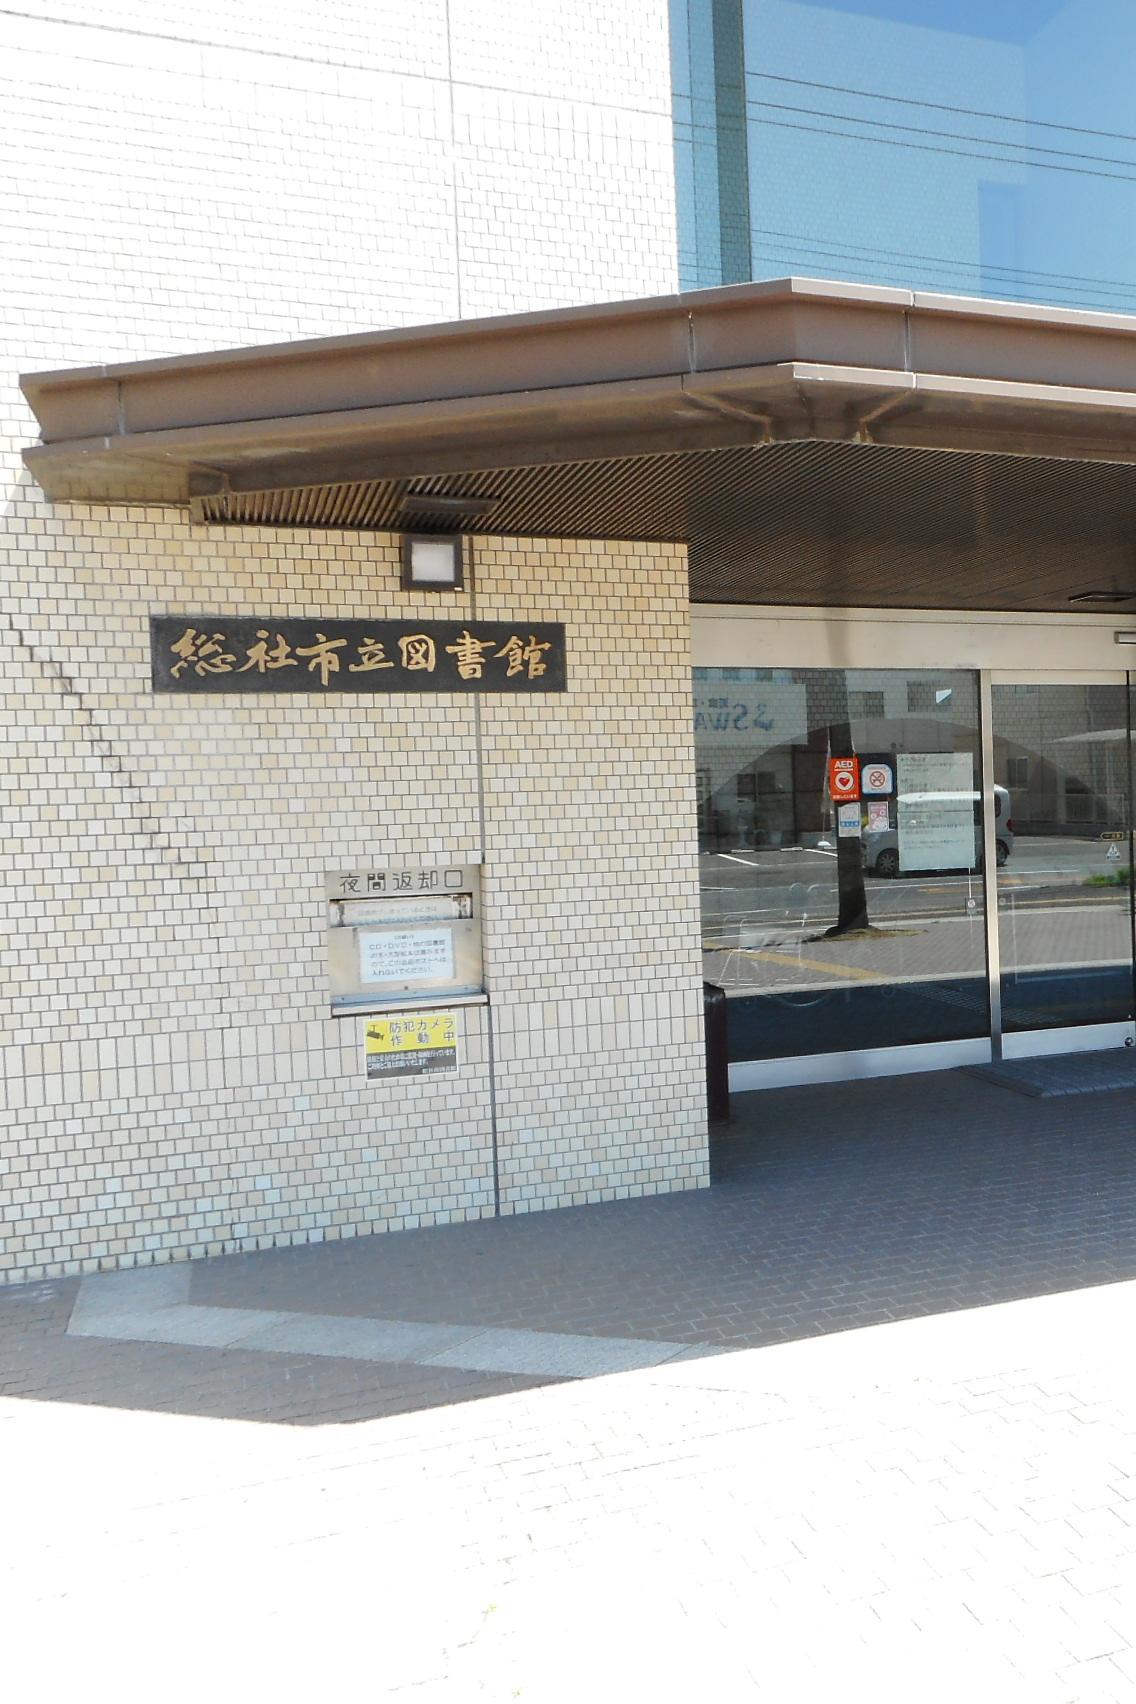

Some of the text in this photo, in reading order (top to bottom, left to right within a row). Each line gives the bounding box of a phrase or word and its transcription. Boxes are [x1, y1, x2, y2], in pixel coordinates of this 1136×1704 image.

[170, 628, 552, 686] 総社市立図書館
[834, 760, 854, 768] AED
[339, 869, 463, 893] 夜間返却口
[390, 1017, 454, 1034] 防犯カメラ
[391, 1031, 454, 1047] 作動中
